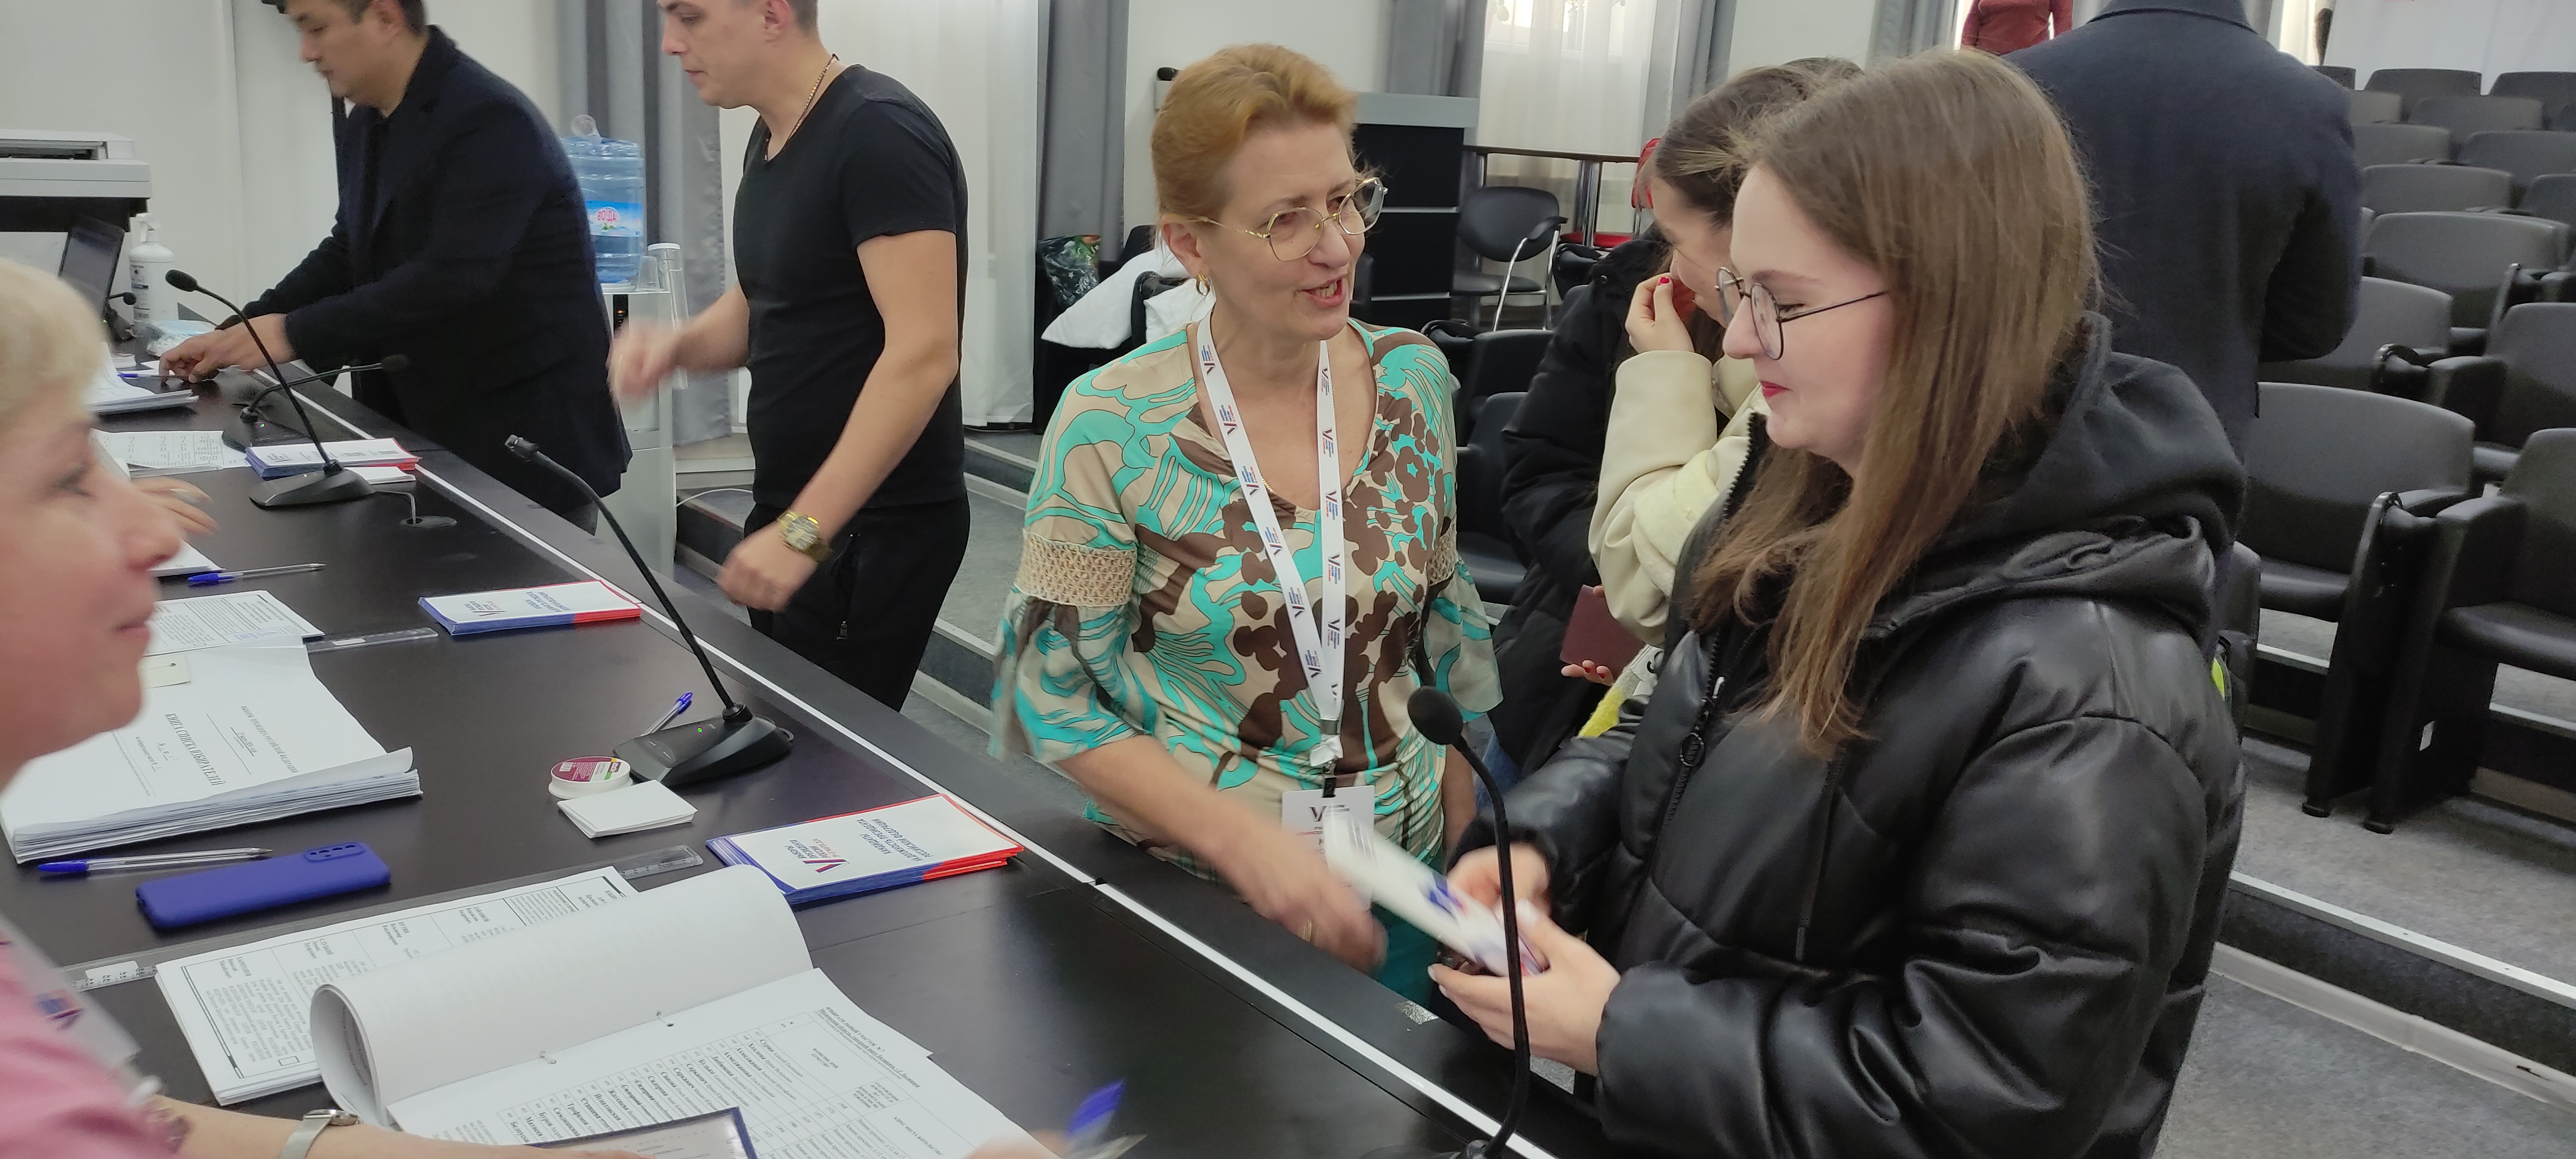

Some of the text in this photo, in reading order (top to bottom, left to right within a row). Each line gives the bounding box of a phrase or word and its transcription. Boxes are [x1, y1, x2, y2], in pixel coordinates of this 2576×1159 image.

[163, 712, 227, 786] КНИГА СПИСКА ИЗБИРАТЕЛЕЙ
[854, 818, 890, 840] ПРЕЗИДЕНТА
[870, 817, 933, 858] РОССИЙСКОЙ ФЕДЕРАЦИИ
[782, 844, 807, 859] ВЫБОРЫ
[787, 838, 820, 859] ПРЕЗИДЕНТА
[807, 845, 831, 859] РОССИИ
[857, 833, 894, 854] КАНДИДАТЫ
[882, 838, 918, 858] ДОЛЖНОСТЬ
[389, 923, 403, 938] Владимир
[398, 921, 410, 933] ПУТИН
[319, 938, 334, 955] СЛУЦКИЙ
[236, 956, 252, 977] ХАРИТОНОВ
[710, 1054, 734, 1077] Любимова
[508, 1121, 531, 1143] Белоусов
